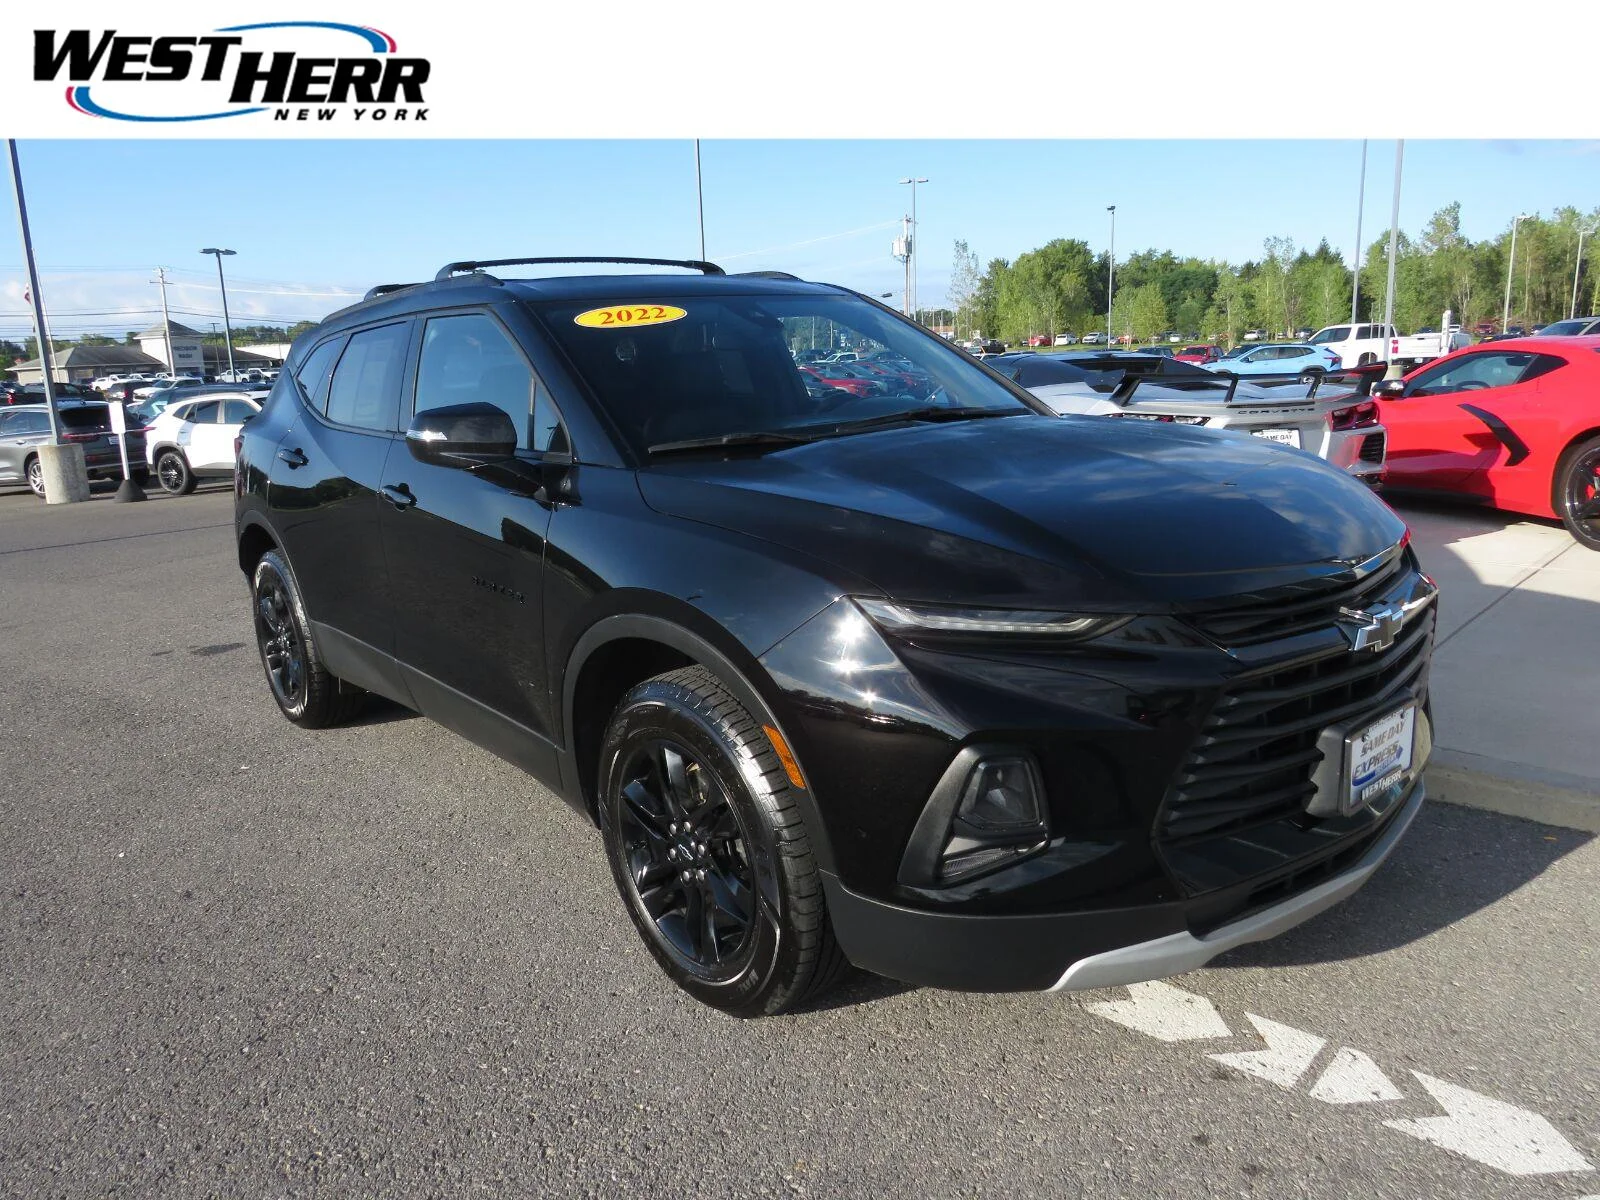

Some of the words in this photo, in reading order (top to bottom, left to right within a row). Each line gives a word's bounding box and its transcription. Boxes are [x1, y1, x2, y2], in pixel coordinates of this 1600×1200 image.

[598, 307, 667, 325] 2022
[1238, 407, 1315, 415] CORVETTE
[1361, 731, 1387, 757] SAME
[1387, 719, 1406, 742] DAY
[1354, 741, 1399, 777] EXPRESS
